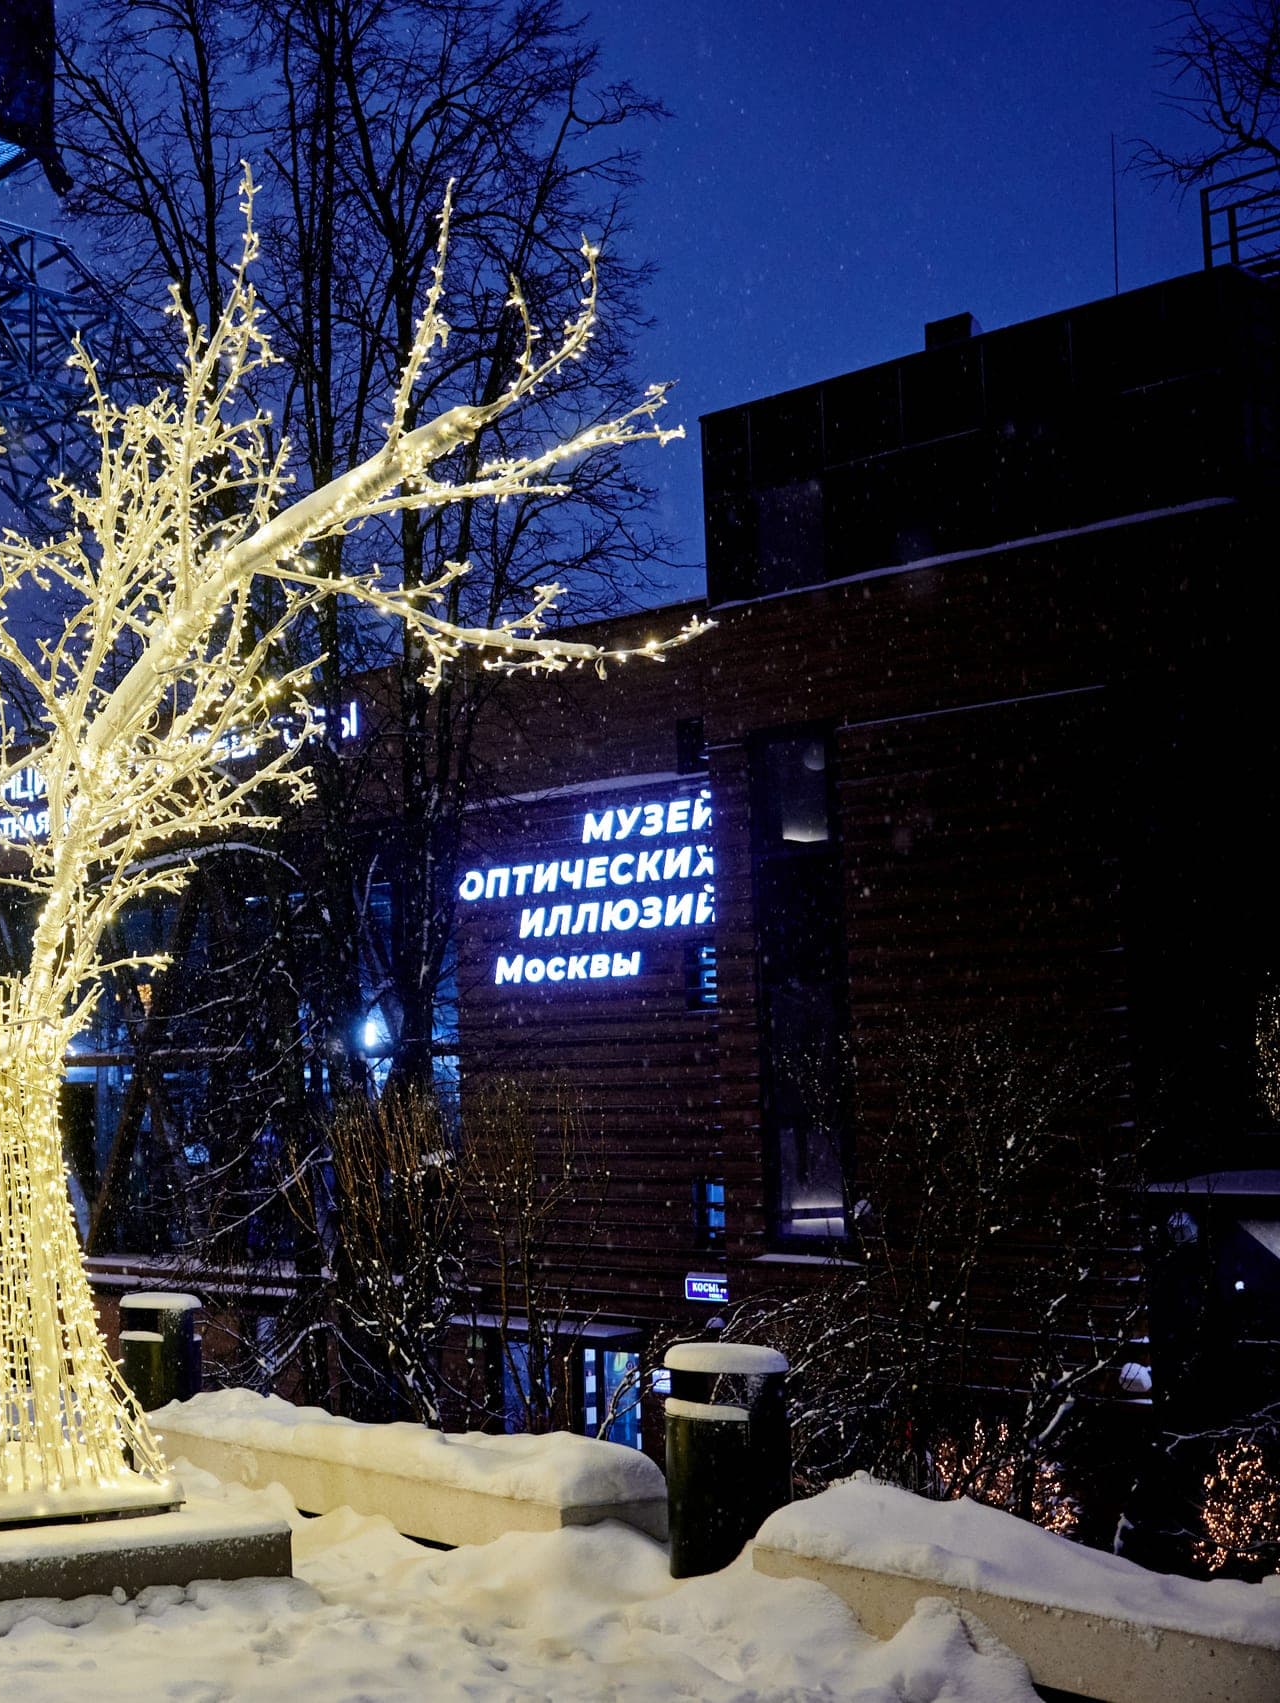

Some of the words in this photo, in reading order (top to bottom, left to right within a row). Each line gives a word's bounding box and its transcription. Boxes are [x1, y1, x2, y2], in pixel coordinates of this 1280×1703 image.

[581, 789, 713, 845] МУЗЕЙ
[458, 845, 715, 902] ОПТИЧЕСКИХ
[518, 883, 716, 939] ИЛЛЮЗИЙ
